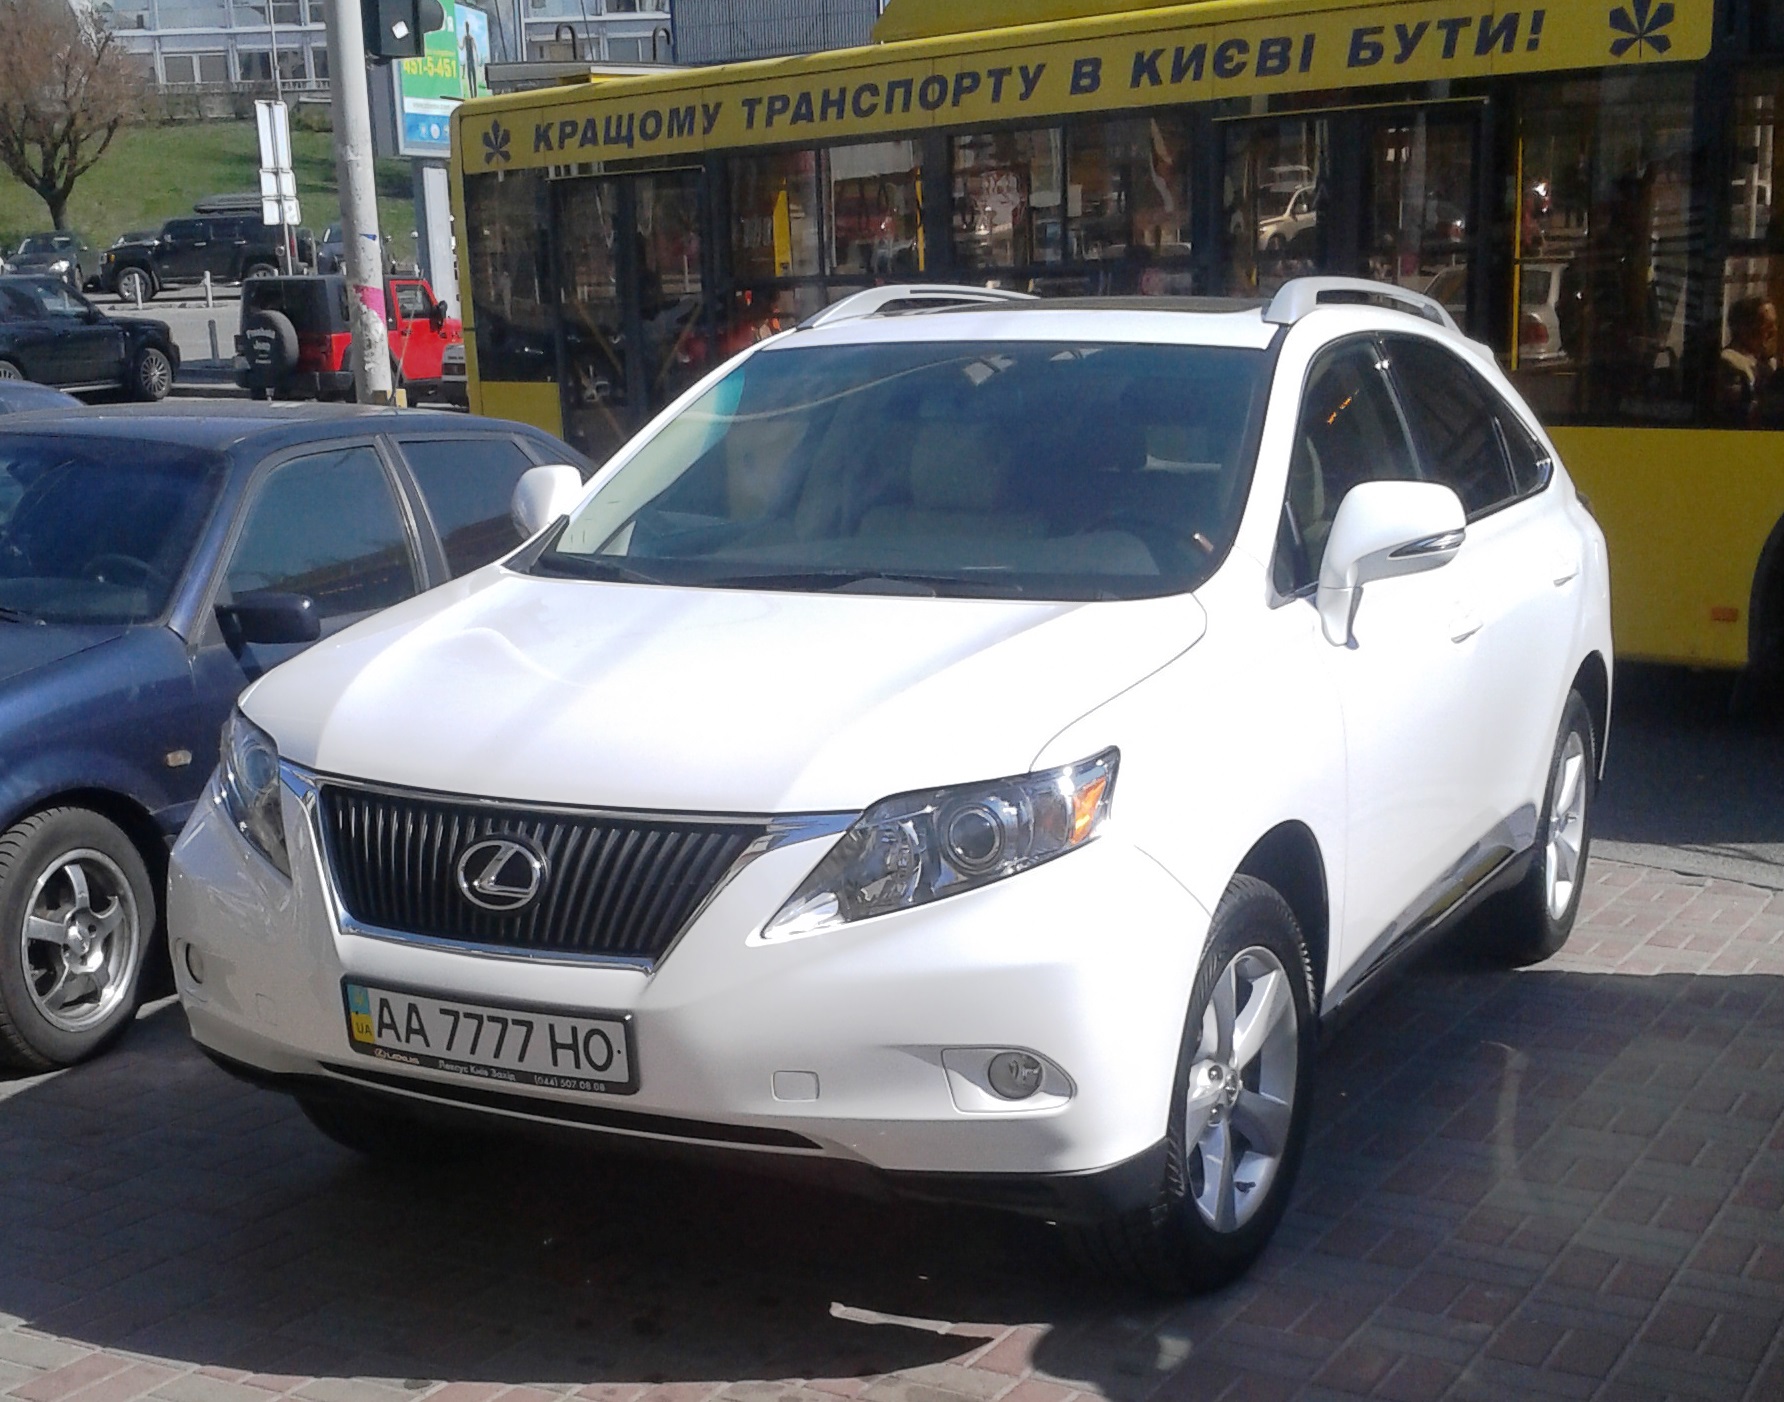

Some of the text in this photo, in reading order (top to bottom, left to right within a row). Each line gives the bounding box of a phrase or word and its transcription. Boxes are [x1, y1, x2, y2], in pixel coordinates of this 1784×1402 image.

[533, 9, 1546, 153] КРАЩОМУ ТРАНСПОРТУ В КИЄВІ БУТИ!
[356, 1022, 373, 1036] UA
[377, 997, 430, 1048] AA
[439, 1008, 534, 1063] 7777
[534, 1074, 559, 1087] (044)
[560, 1078, 577, 1089] 507
